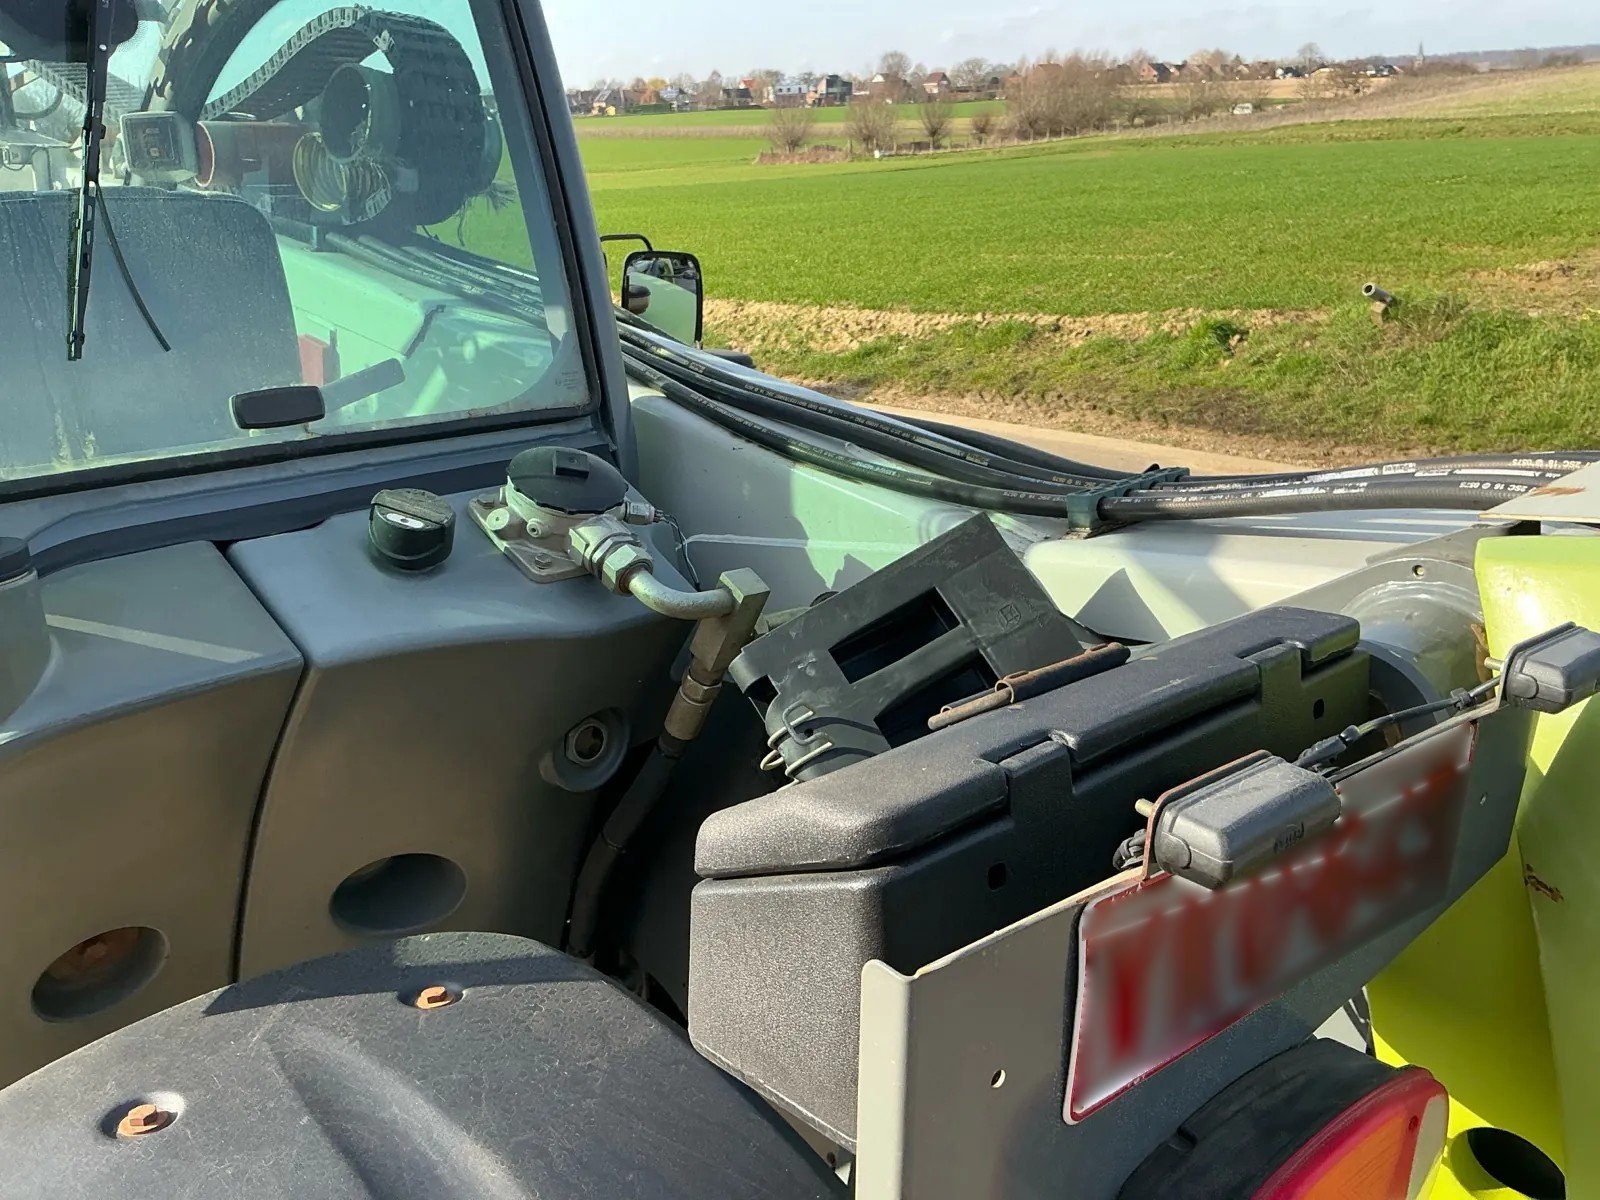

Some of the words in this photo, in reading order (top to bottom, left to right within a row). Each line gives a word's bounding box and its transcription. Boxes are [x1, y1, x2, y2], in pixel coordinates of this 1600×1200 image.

[1383, 463, 1410, 473] Parker
[1562, 460, 1582, 469] 2SC
[1506, 484, 1528, 492] 2SC
